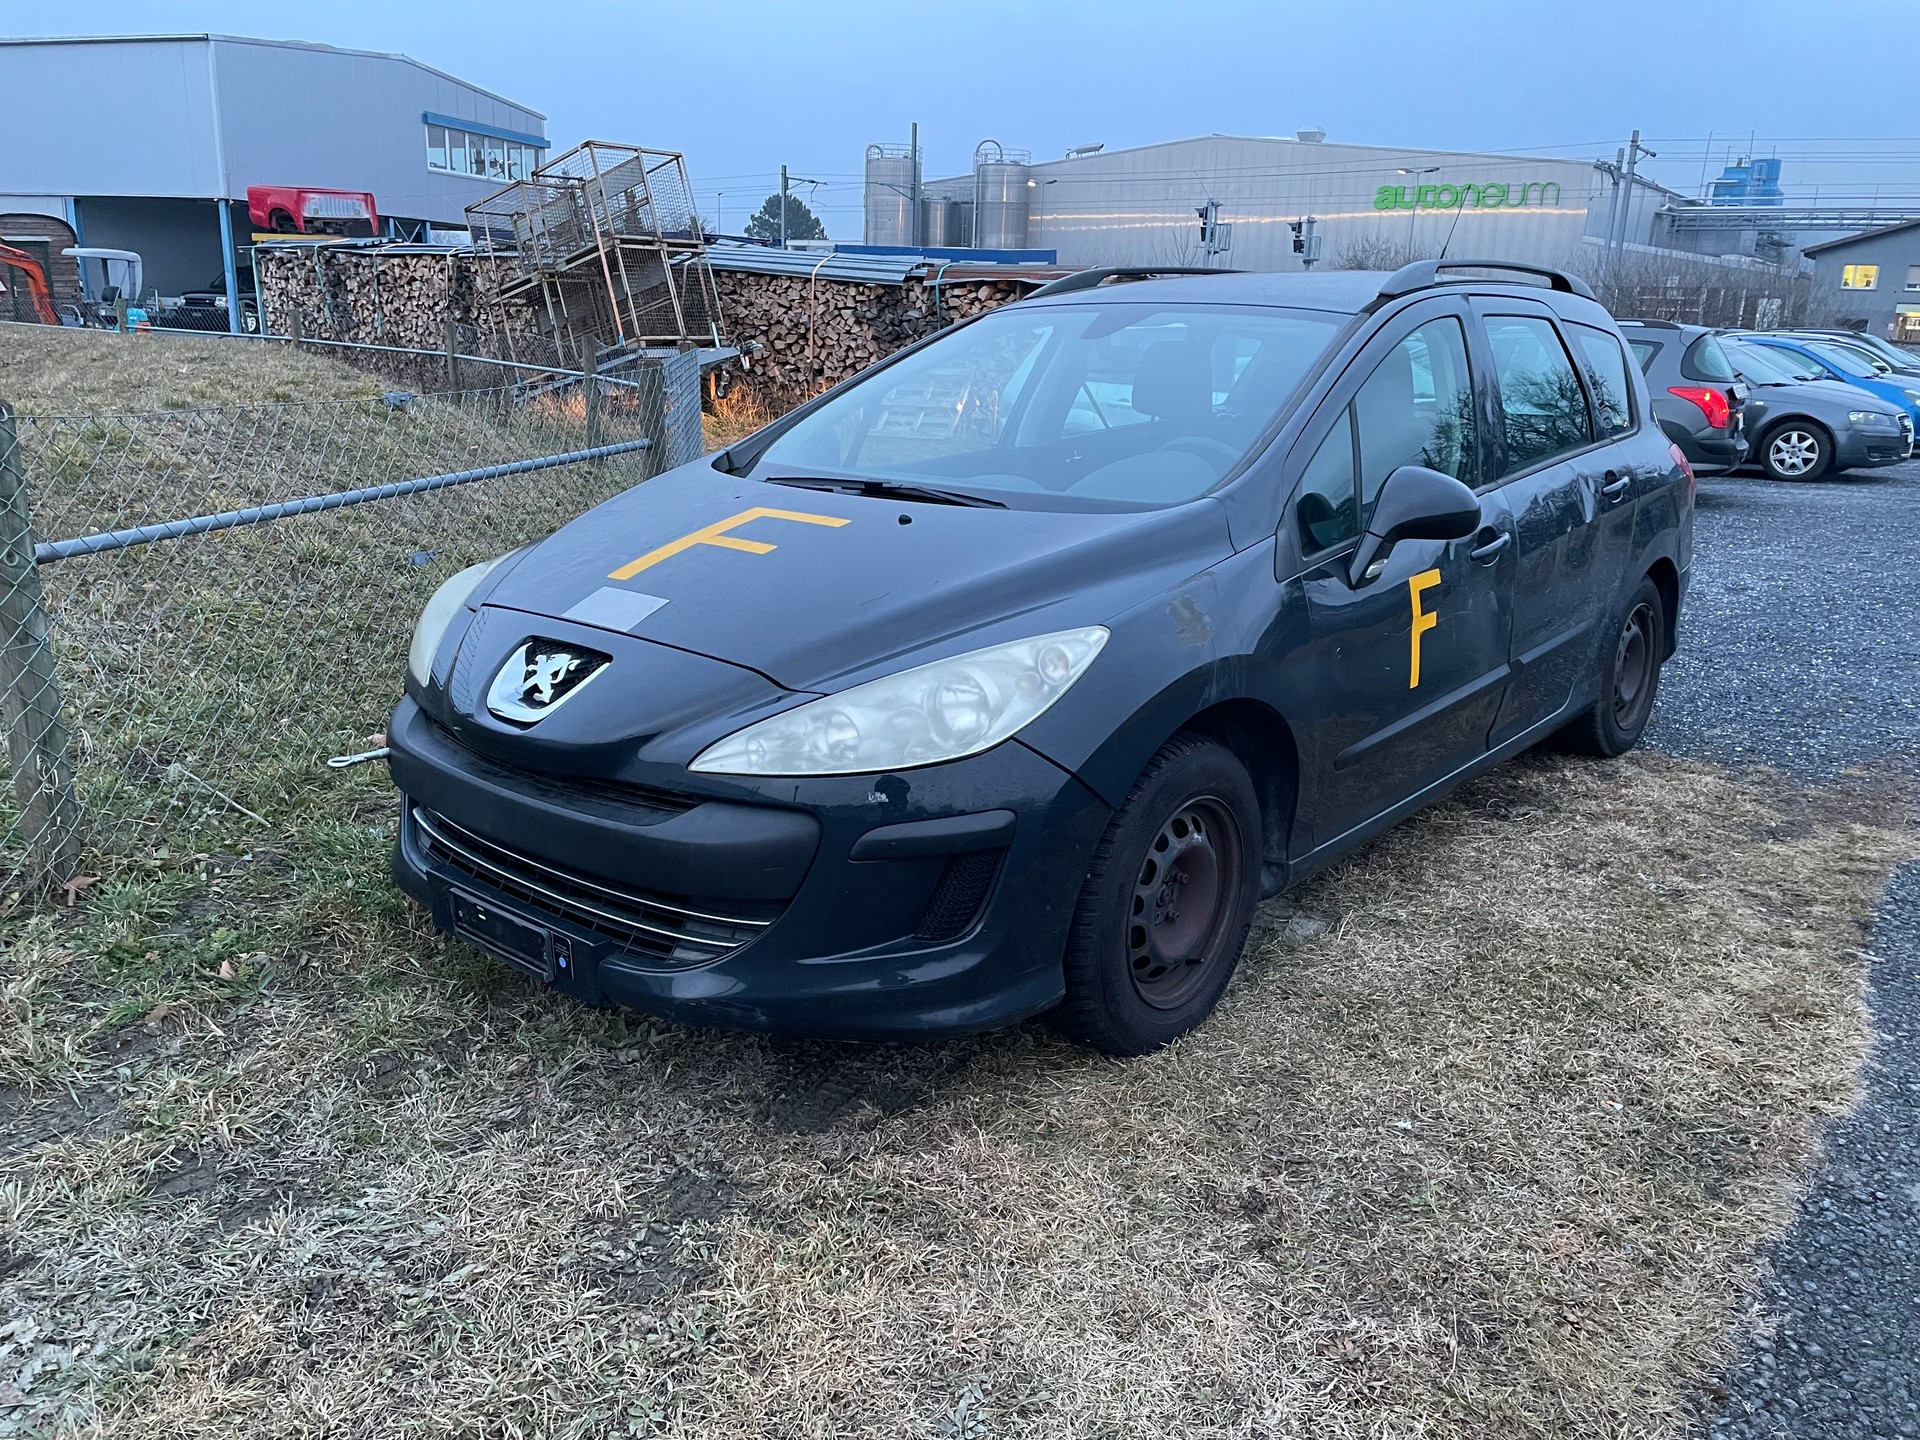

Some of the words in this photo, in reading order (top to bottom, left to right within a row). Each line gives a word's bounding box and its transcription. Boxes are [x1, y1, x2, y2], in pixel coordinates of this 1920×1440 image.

[1374, 181, 1560, 210] autoneum
[607, 507, 852, 580] F
[1409, 568, 1441, 689] F
